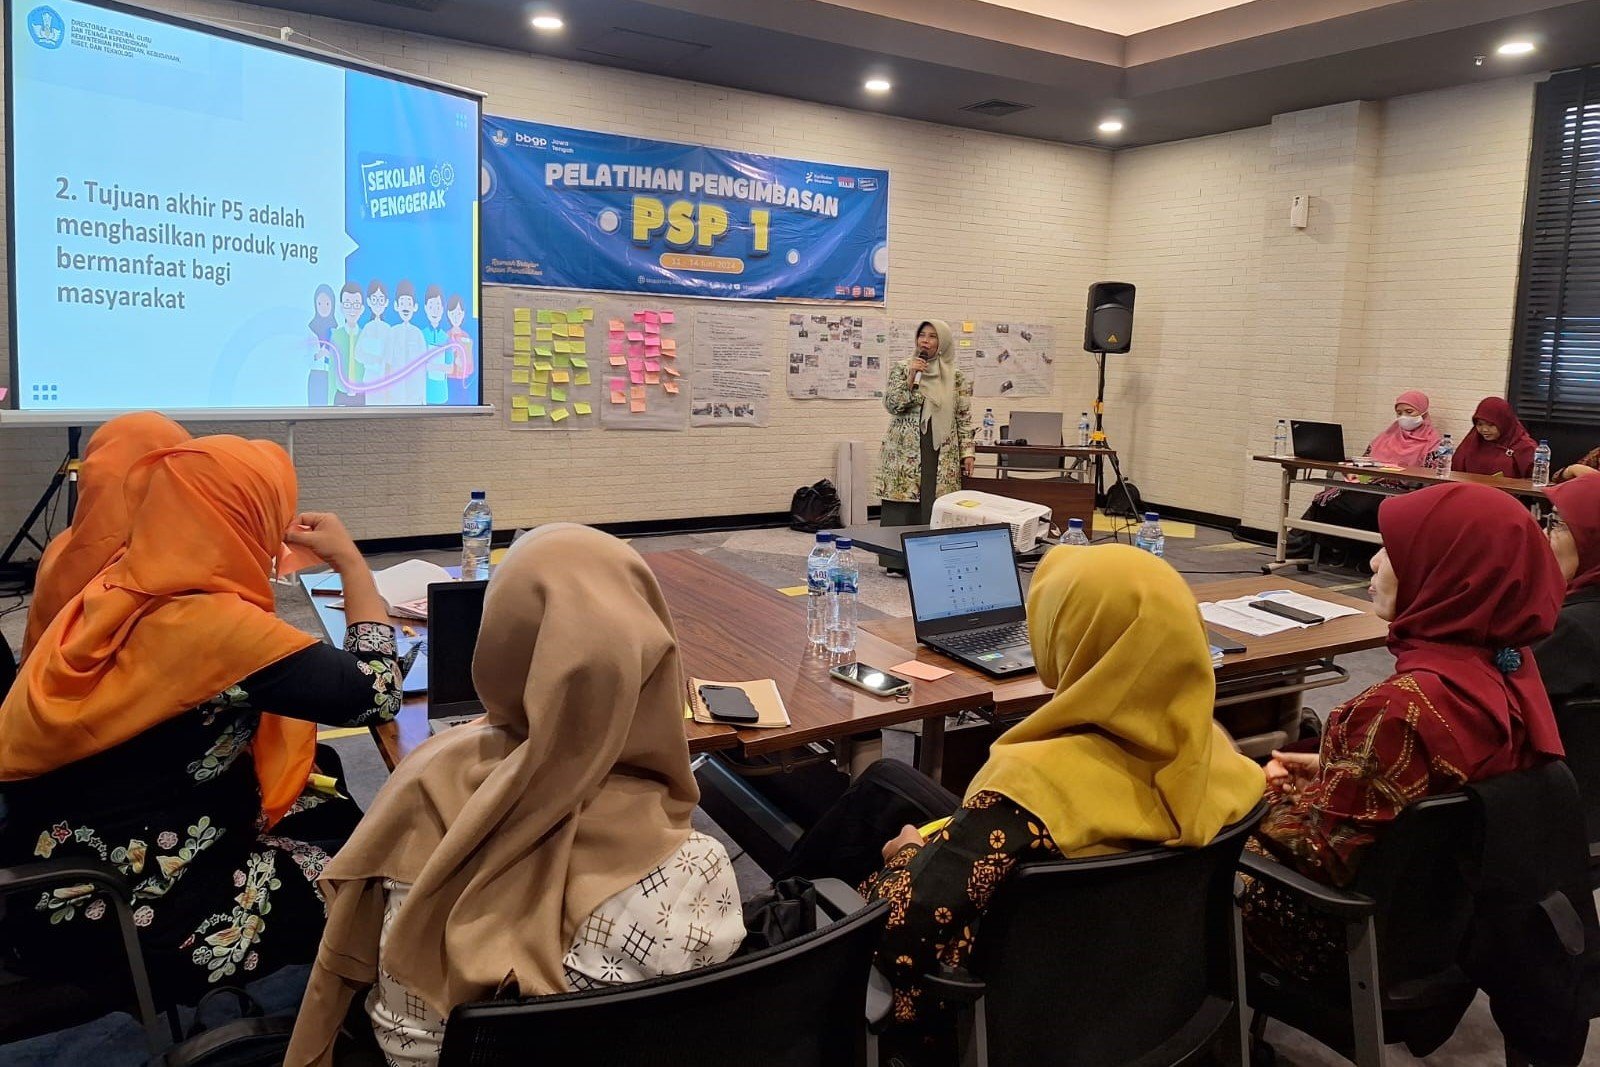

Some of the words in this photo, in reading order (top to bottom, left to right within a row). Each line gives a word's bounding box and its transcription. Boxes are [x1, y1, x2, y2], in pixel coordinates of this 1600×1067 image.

[71, 19, 107, 32] DIREKTORAT
[136, 35, 152, 43] GURU
[71, 25, 84, 33] DAN
[84, 28, 108, 40] TENAGA
[71, 33, 112, 46] KEMENTERIAN
[89, 42, 102, 51] DAN
[104, 46, 134, 57] TEKNOLOGI
[515, 132, 547, 147] bbgp
[367, 165, 426, 192] SEKOLAH
[544, 162, 683, 192] PELATIHAN
[689, 172, 839, 218] PENGIMBASAN
[55, 176, 77, 201] 2.
[83, 180, 159, 211] Tujuan
[166, 192, 216, 218] akhir
[221, 199, 243, 221] P5
[248, 204, 305, 229] adalah
[370, 188, 446, 219] PENGGERAK
[632, 195, 729, 247] PSP
[750, 209, 770, 252] 1
[56, 216, 206, 249] menghasilkan
[212, 232, 276, 255] produk
[279, 241, 319, 264] yang
[56, 245, 187, 279] bermanfaat
[192, 258, 231, 286] bagi
[57, 285, 186, 311] masyarakat
